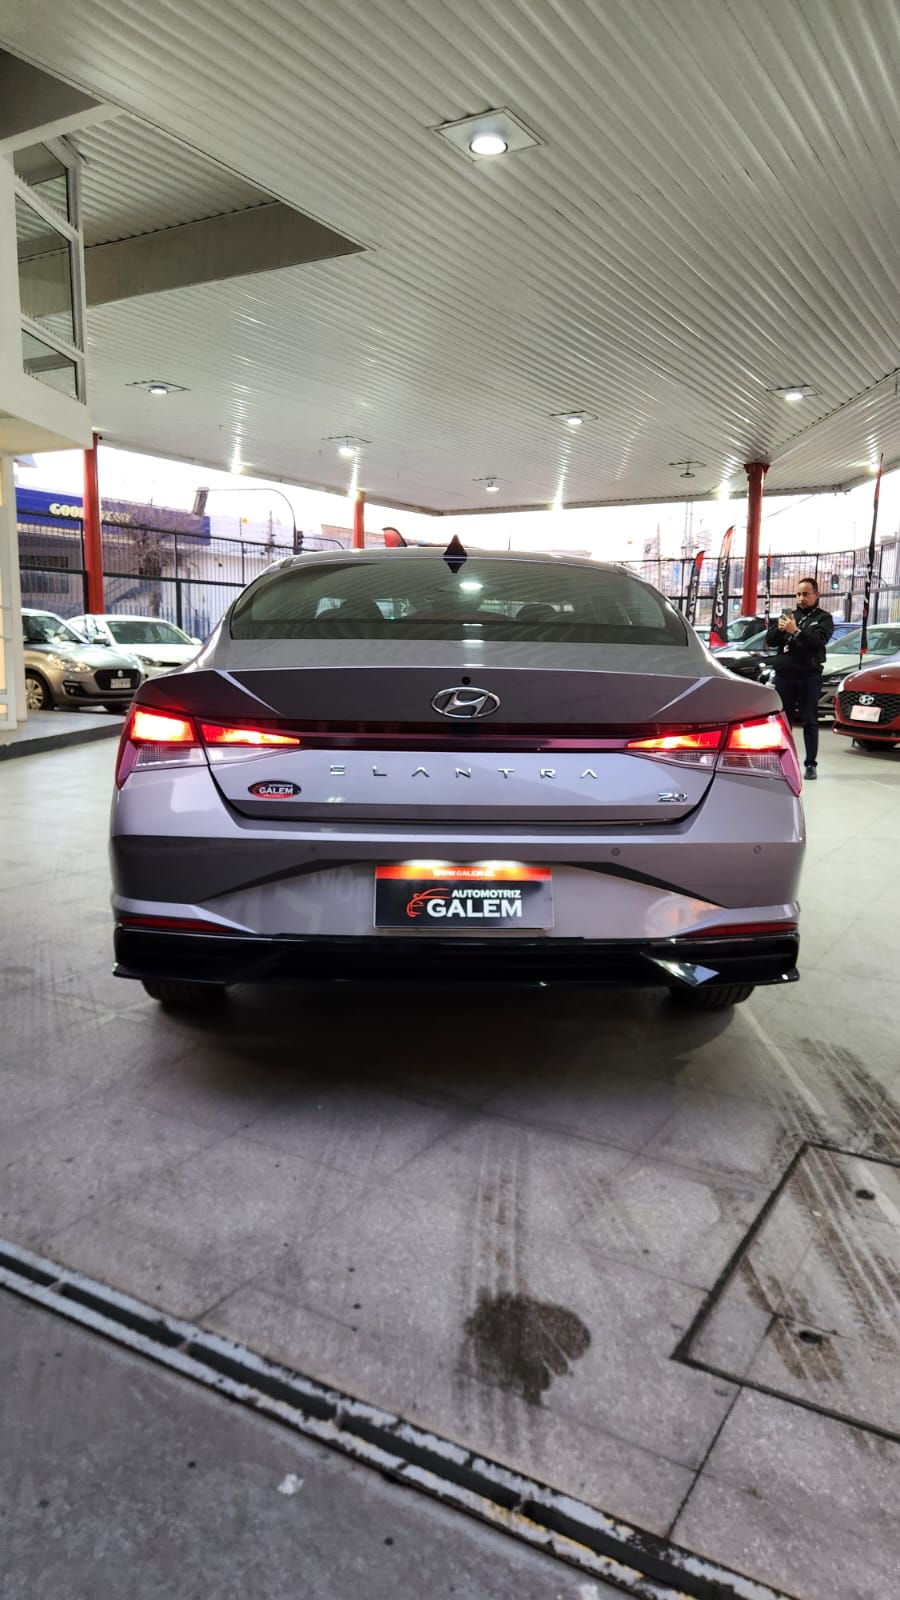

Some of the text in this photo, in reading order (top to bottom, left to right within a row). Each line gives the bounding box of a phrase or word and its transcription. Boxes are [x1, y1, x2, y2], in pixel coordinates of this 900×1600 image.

[329, 765, 598, 779] ELANTRA
[259, 786, 294, 795] GALEM
[451, 889, 522, 898] AUTOMOTRIZ
[426, 898, 523, 918] GALEM
